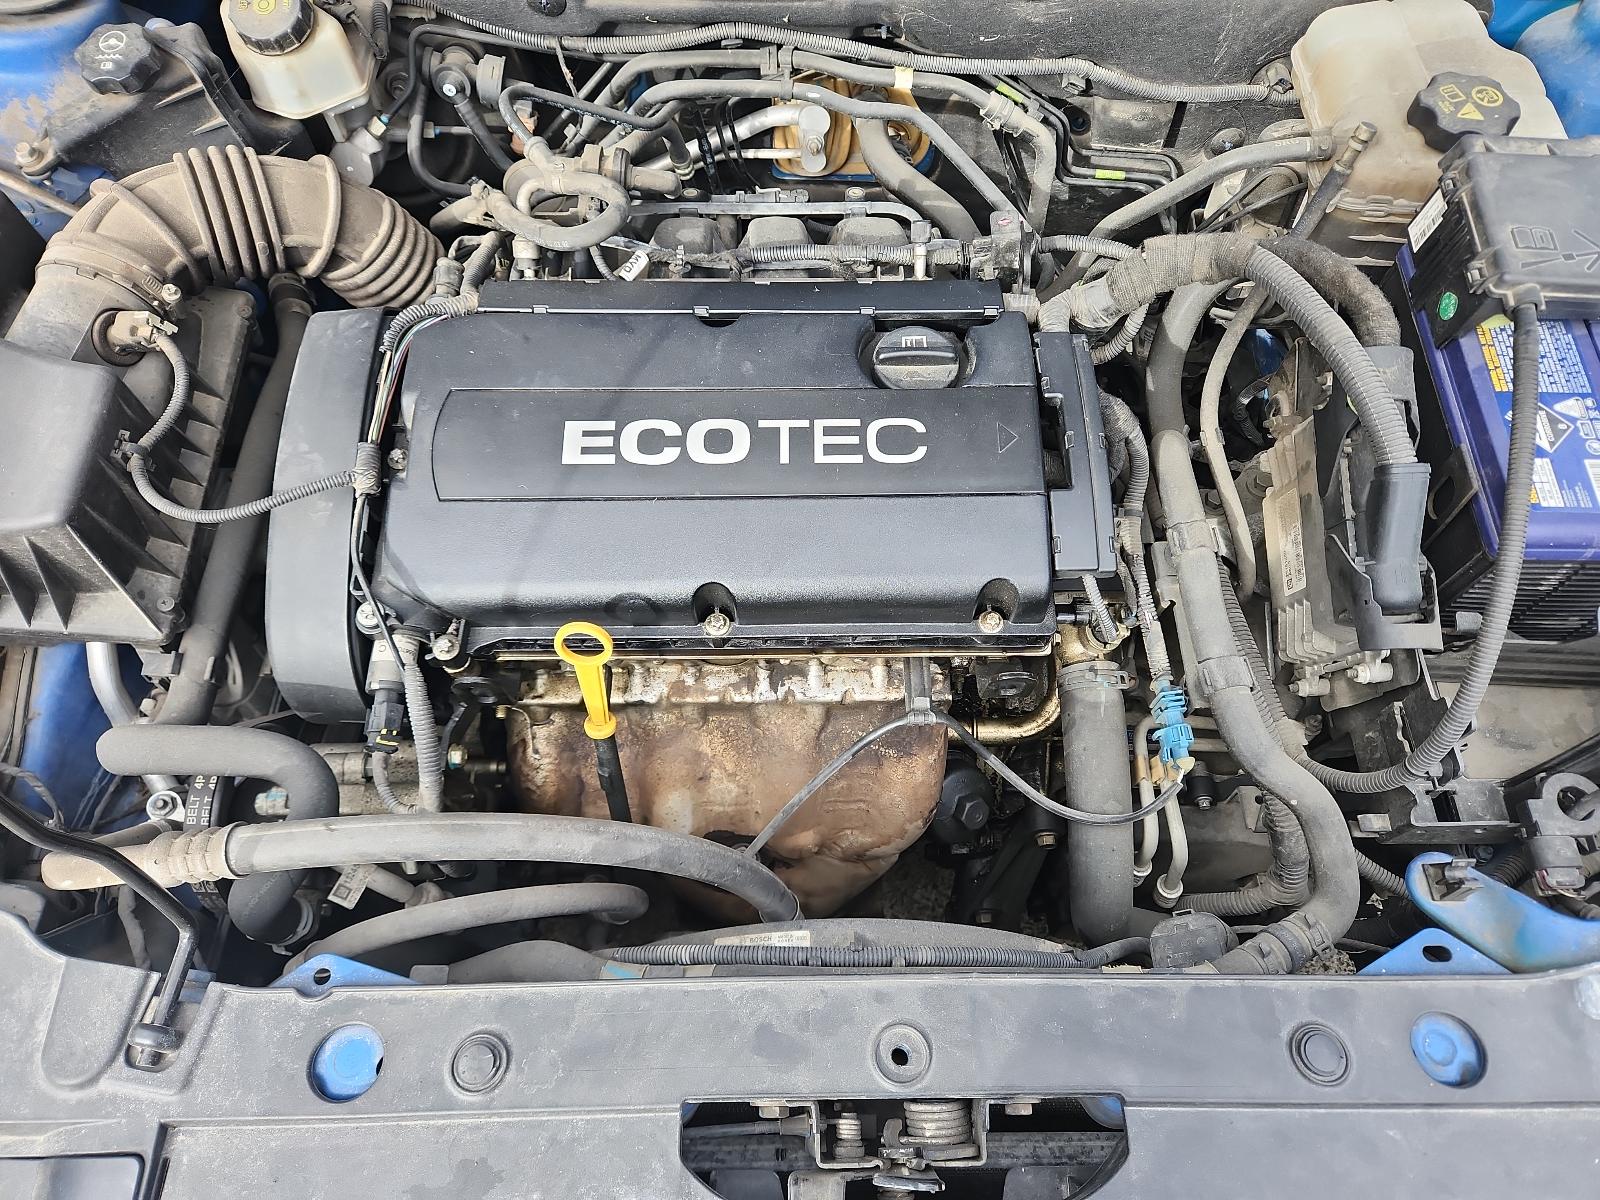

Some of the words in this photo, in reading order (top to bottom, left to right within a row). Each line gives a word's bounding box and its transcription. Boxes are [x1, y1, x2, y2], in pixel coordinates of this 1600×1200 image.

[561, 417, 928, 465] ECOTEC
[186, 795, 200, 825] BELT
[194, 775, 206, 790] 4P
[749, 935, 772, 943] BOSCH
